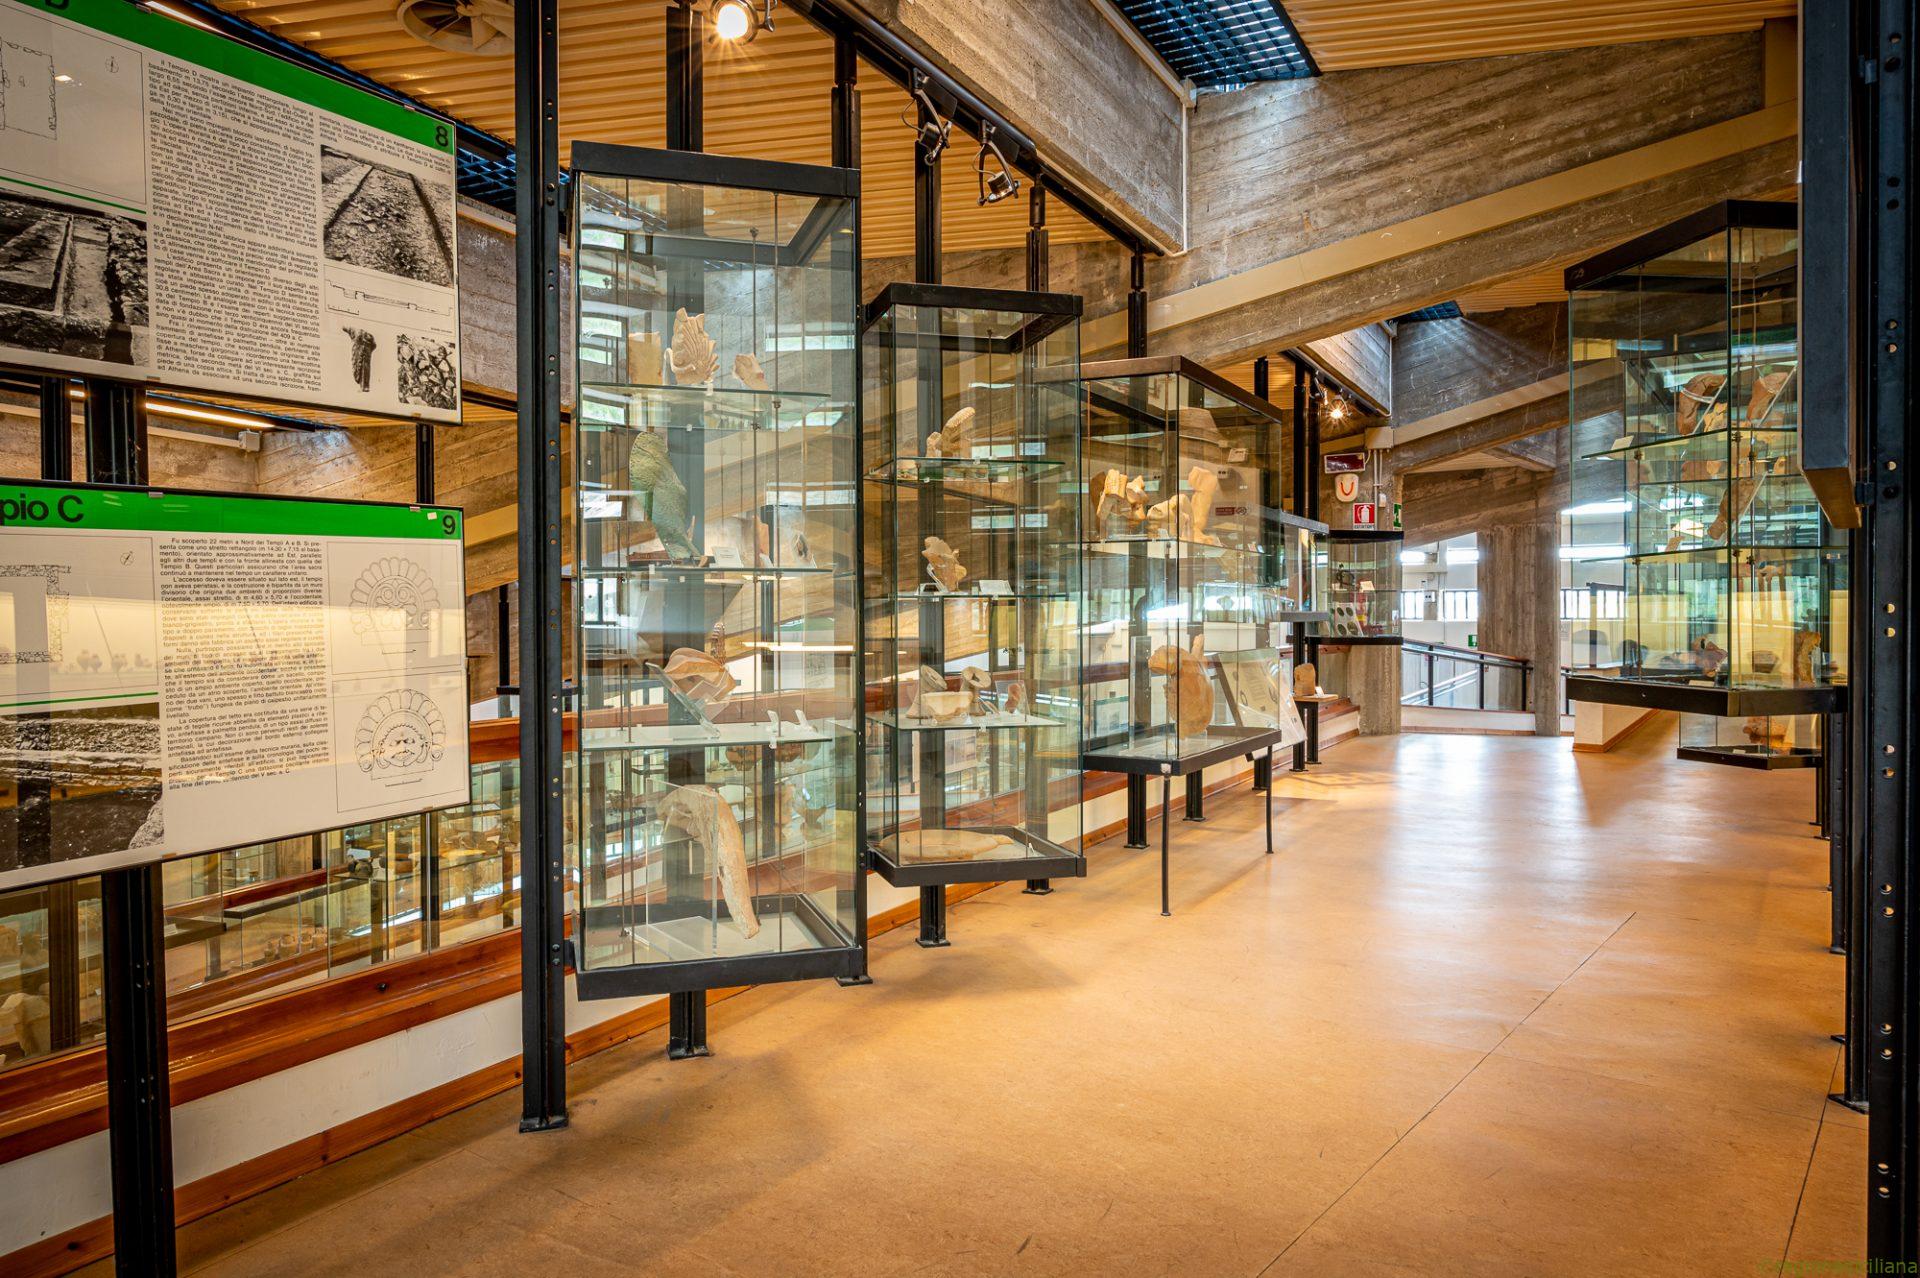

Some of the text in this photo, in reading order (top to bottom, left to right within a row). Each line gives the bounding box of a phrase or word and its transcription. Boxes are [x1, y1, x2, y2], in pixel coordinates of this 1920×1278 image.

[435, 125, 449, 147] 8
[58, 494, 84, 523] C
[442, 514, 456, 535] 9
